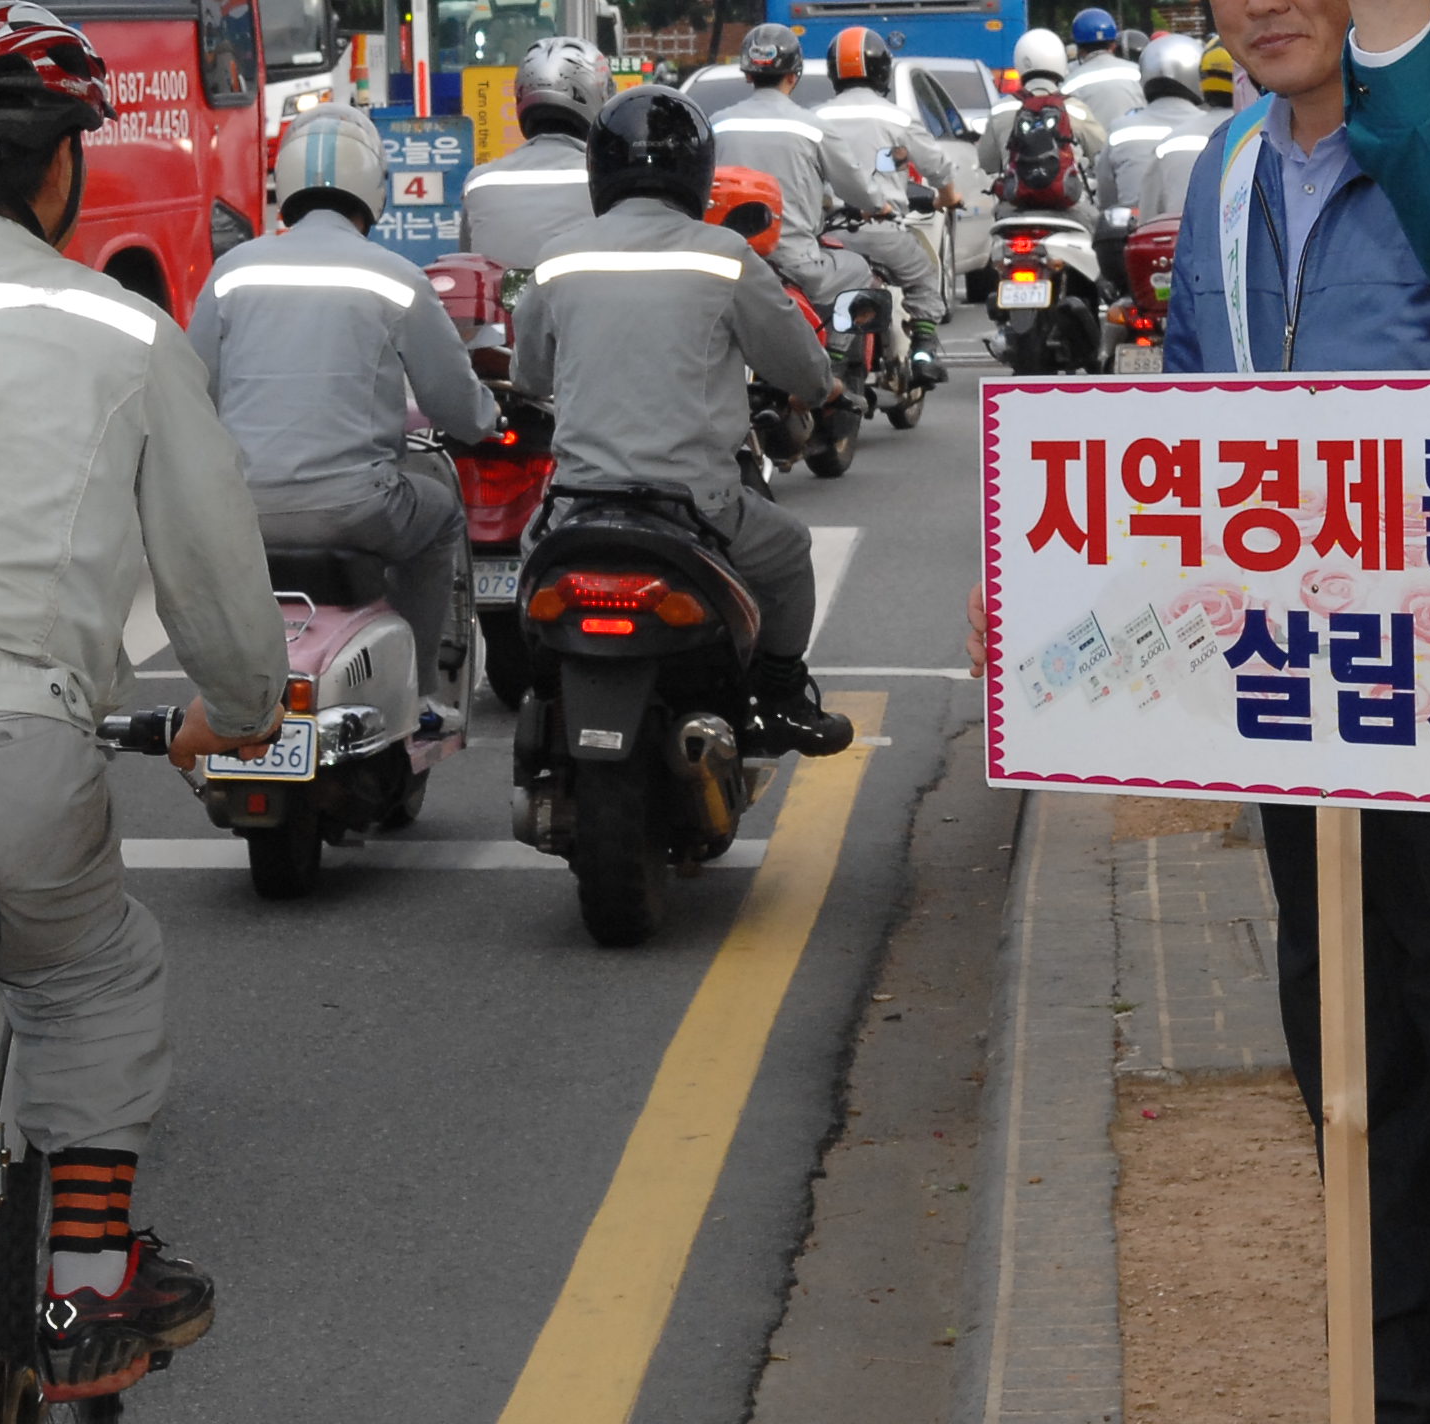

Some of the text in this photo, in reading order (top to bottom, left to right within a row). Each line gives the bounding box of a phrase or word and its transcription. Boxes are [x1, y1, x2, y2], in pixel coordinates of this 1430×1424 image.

[476, 80, 489, 108] Turn
[478, 111, 488, 126] on
[382, 136, 462, 166] 오늘은
[477, 129, 489, 148] the
[404, 176, 428, 199] 4
[1078, 647, 1108, 674] 10,000
